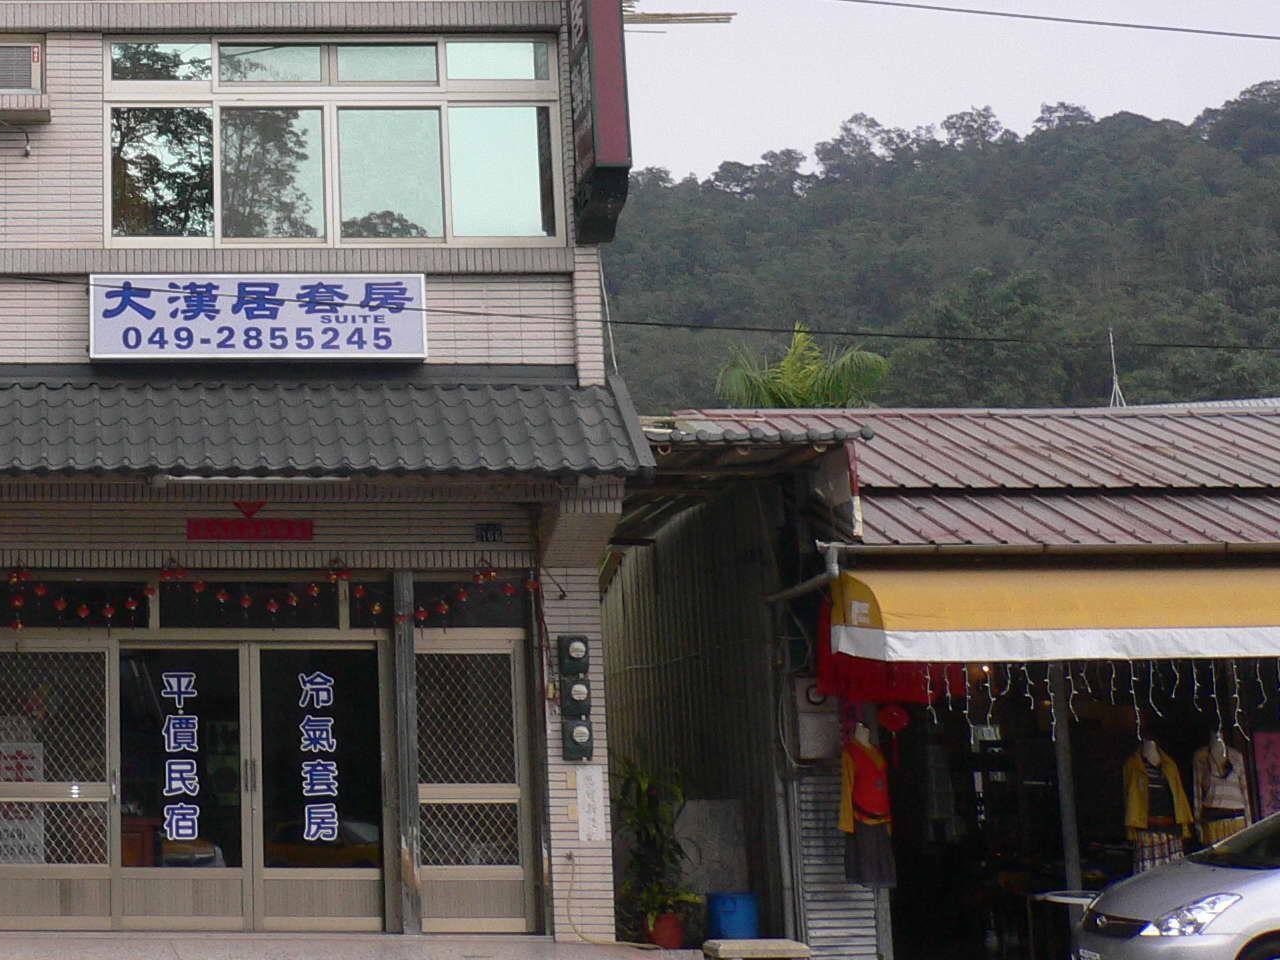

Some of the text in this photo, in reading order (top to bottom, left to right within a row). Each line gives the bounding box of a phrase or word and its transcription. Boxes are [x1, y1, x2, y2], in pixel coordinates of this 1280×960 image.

[102, 280, 414, 321] 大漢居套房
[320, 314, 386, 324] SUITE
[122, 326, 393, 350] 049-2855245
[161, 672, 199, 841] 平價民宿
[298, 671, 338, 841] 冷氣套房
